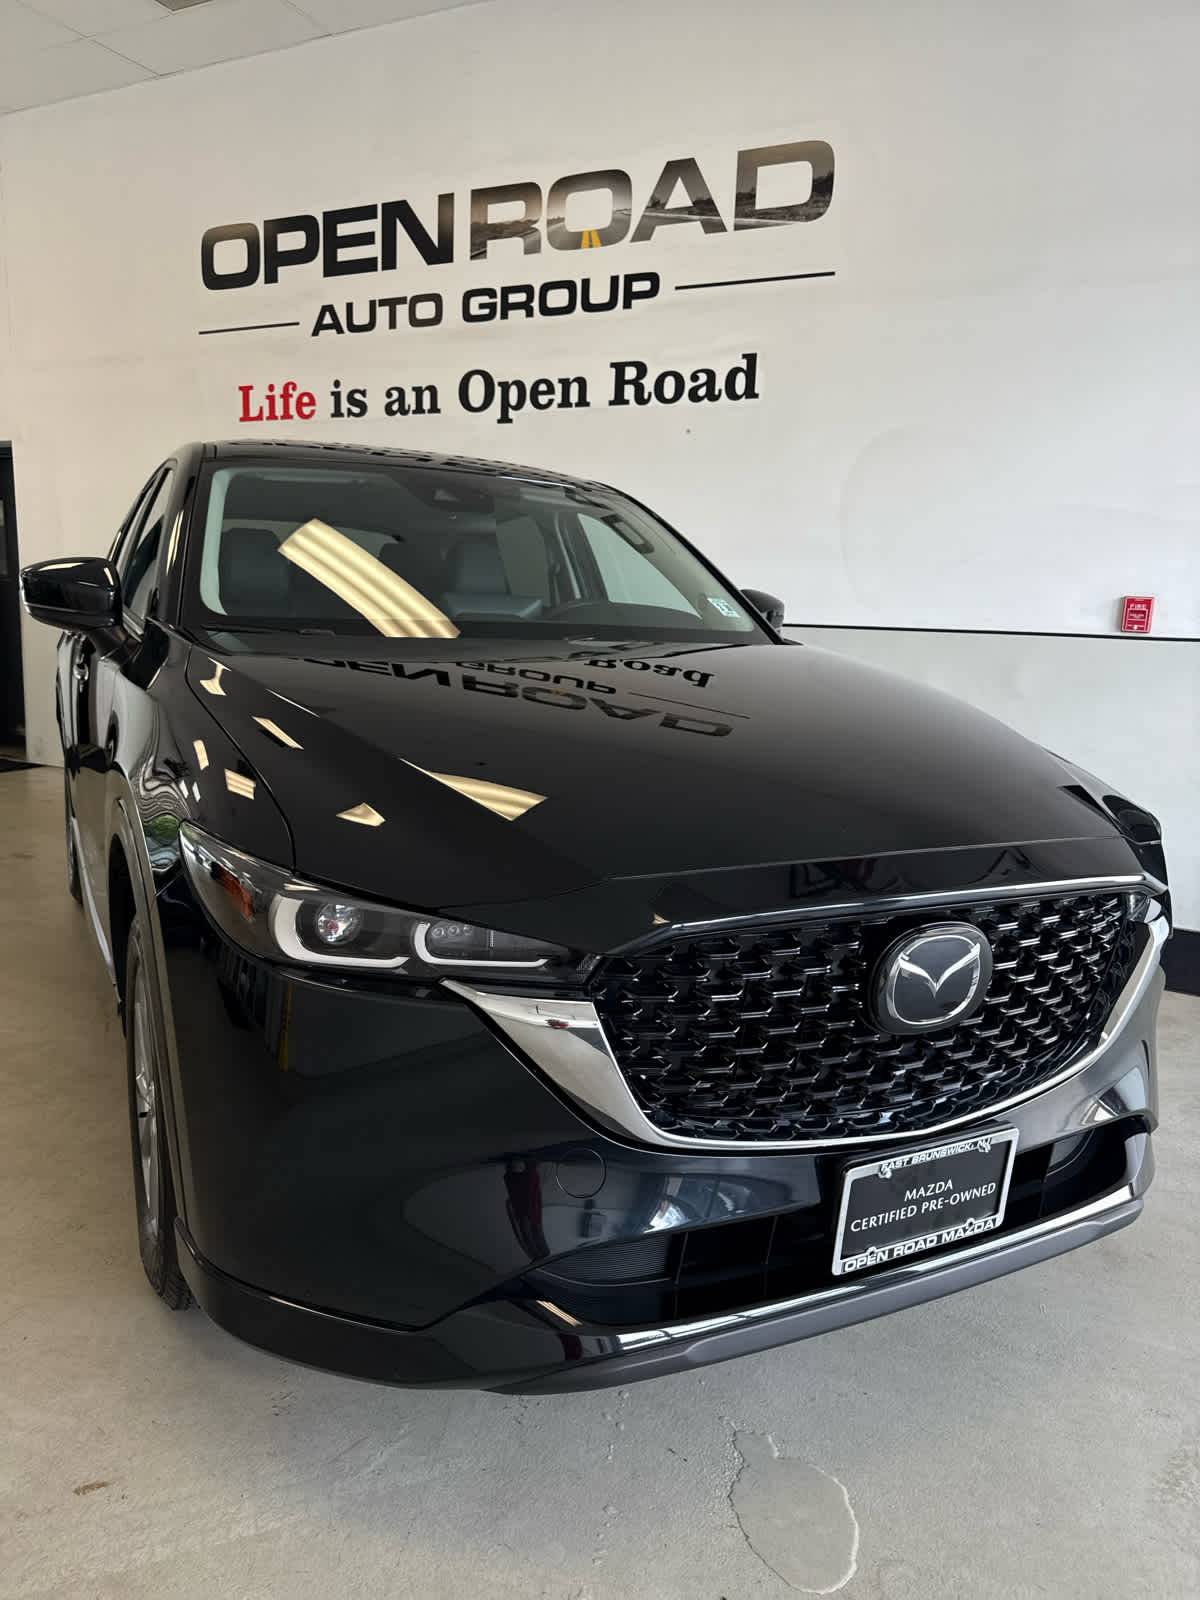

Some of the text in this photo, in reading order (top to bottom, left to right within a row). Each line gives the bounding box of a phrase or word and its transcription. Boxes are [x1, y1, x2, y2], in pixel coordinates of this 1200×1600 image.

[200, 140, 836, 291] OPEN ROAD
[310, 271, 661, 338] AUTO GROUP
[237, 352, 760, 425] Life is an Open Road
[850, 1181, 997, 1232] CERTIFIED PRE-OWNED
[903, 1178, 954, 1202] MAZDA
[843, 1218, 995, 1273] OPEN ROAD MAZDA
